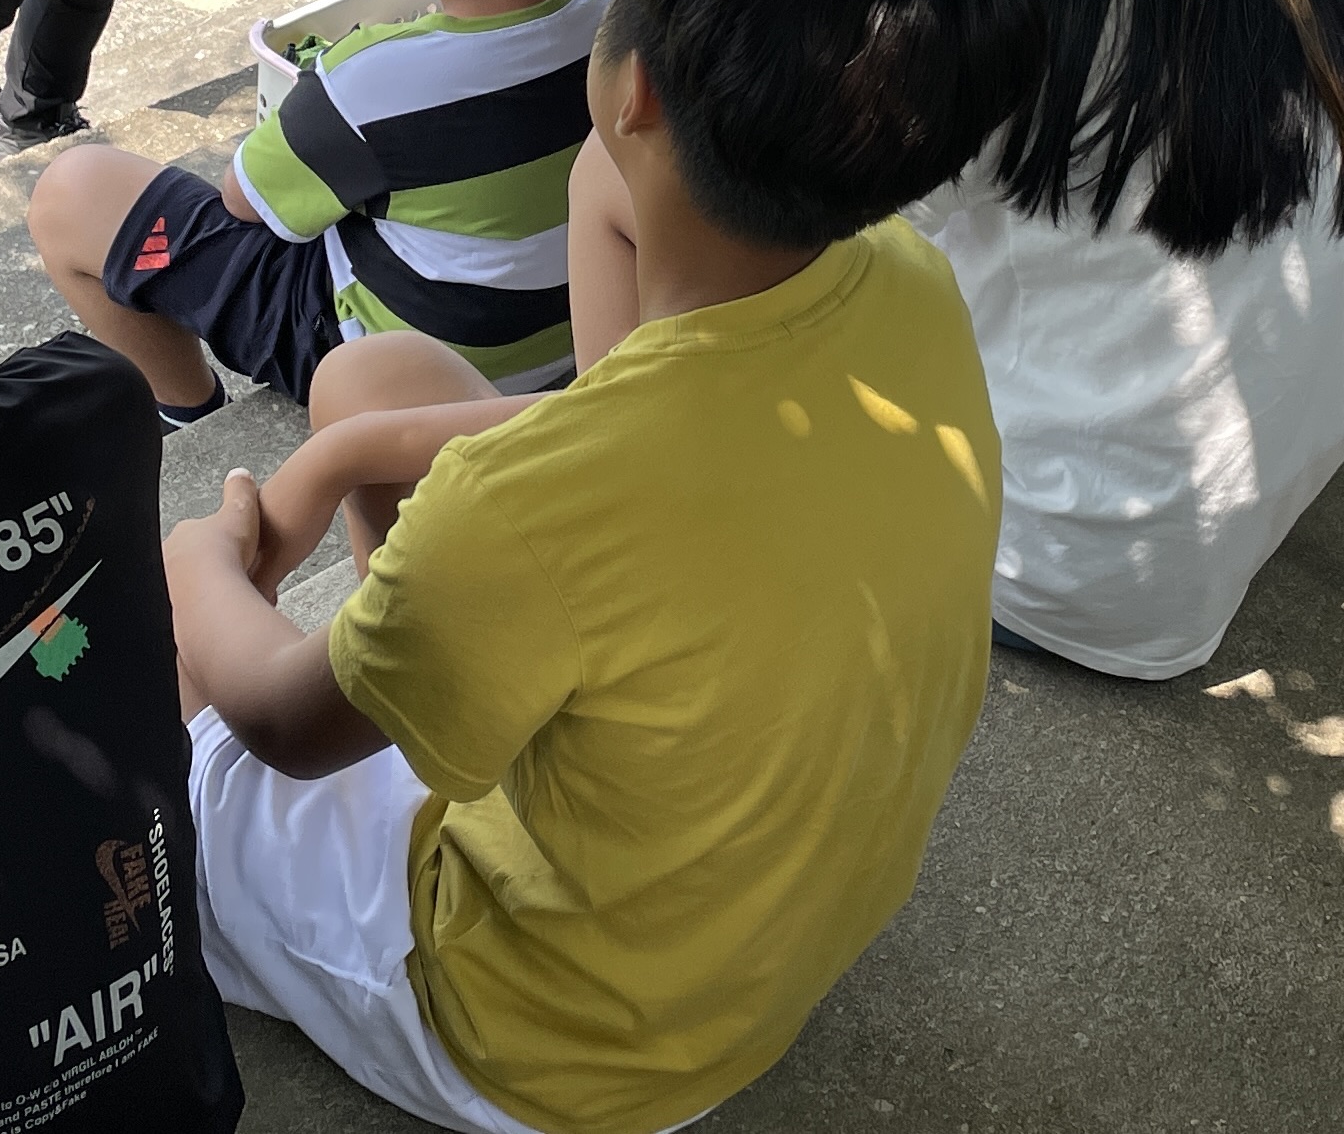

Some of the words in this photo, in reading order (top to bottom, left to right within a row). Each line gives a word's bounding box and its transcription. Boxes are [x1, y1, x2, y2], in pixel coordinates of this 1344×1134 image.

[28, 952, 158, 1067] "AIR"
[0, 1100, 13, 1112] to
[61, 1057, 97, 1082] VIRGIL
[24, 1091, 63, 1118] PASTE
[64, 1063, 113, 1097] therefore
[115, 1056, 120, 1068] I
[120, 1048, 137, 1065] am
[136, 1025, 160, 1053] FAKE
[25, 1090, 88, 1131] Copy&Fake
